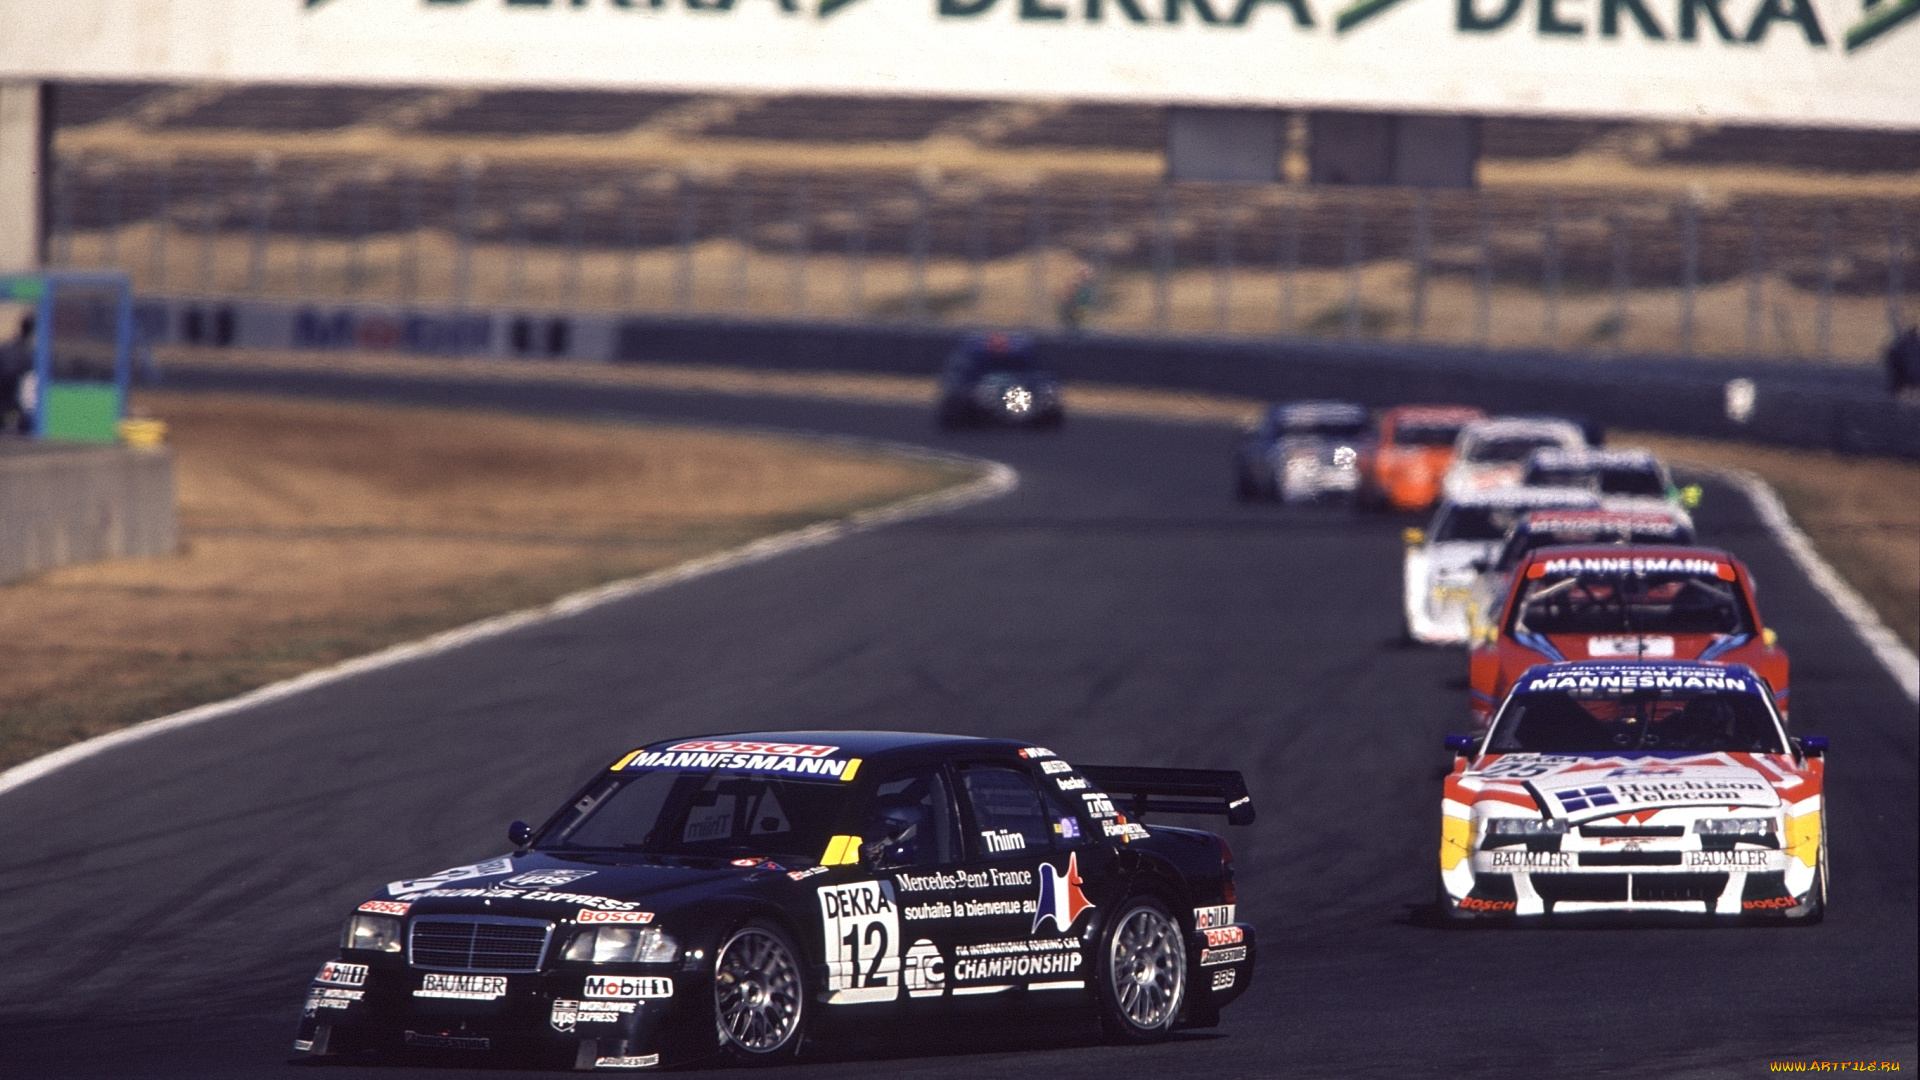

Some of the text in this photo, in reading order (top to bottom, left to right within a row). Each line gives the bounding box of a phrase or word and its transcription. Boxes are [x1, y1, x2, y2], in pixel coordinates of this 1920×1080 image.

[1545, 559, 1719, 574] MANNESMANN
[1529, 676, 1746, 691] MANNESMANN
[674, 741, 835, 757] BOSCH
[630, 752, 847, 776] MANNESMANN
[1617, 781, 1765, 792] Hutchison
[1621, 789, 1742, 802] Telecom
[981, 829, 1026, 852] Thiim
[895, 868, 1032, 891] Mercedes-Benz France
[359, 901, 411, 915] BOSCH
[522, 892, 641, 911] EXPRESS
[824, 886, 892, 919] DEKRA
[904, 899, 1037, 920] souhaite la bienvenue au
[1459, 896, 1517, 910] BOSCH
[1742, 896, 1799, 910] BOSCH
[578, 910, 653, 922] BOSCH
[1208, 928, 1244, 946] BOSCH
[842, 920, 889, 988] 12
[970, 942, 1029, 956] INTERNATIONAL
[1064, 937, 1081, 949] CAR
[317, 963, 351, 982] obil
[954, 952, 1083, 981] CHAMPIONSHIP
[586, 977, 670, 996] Mobil 1
[1211, 968, 1236, 991] BBS
[579, 1001, 637, 1013] WORLDWIDE
[552, 1012, 619, 1027] ups EXPRESS
